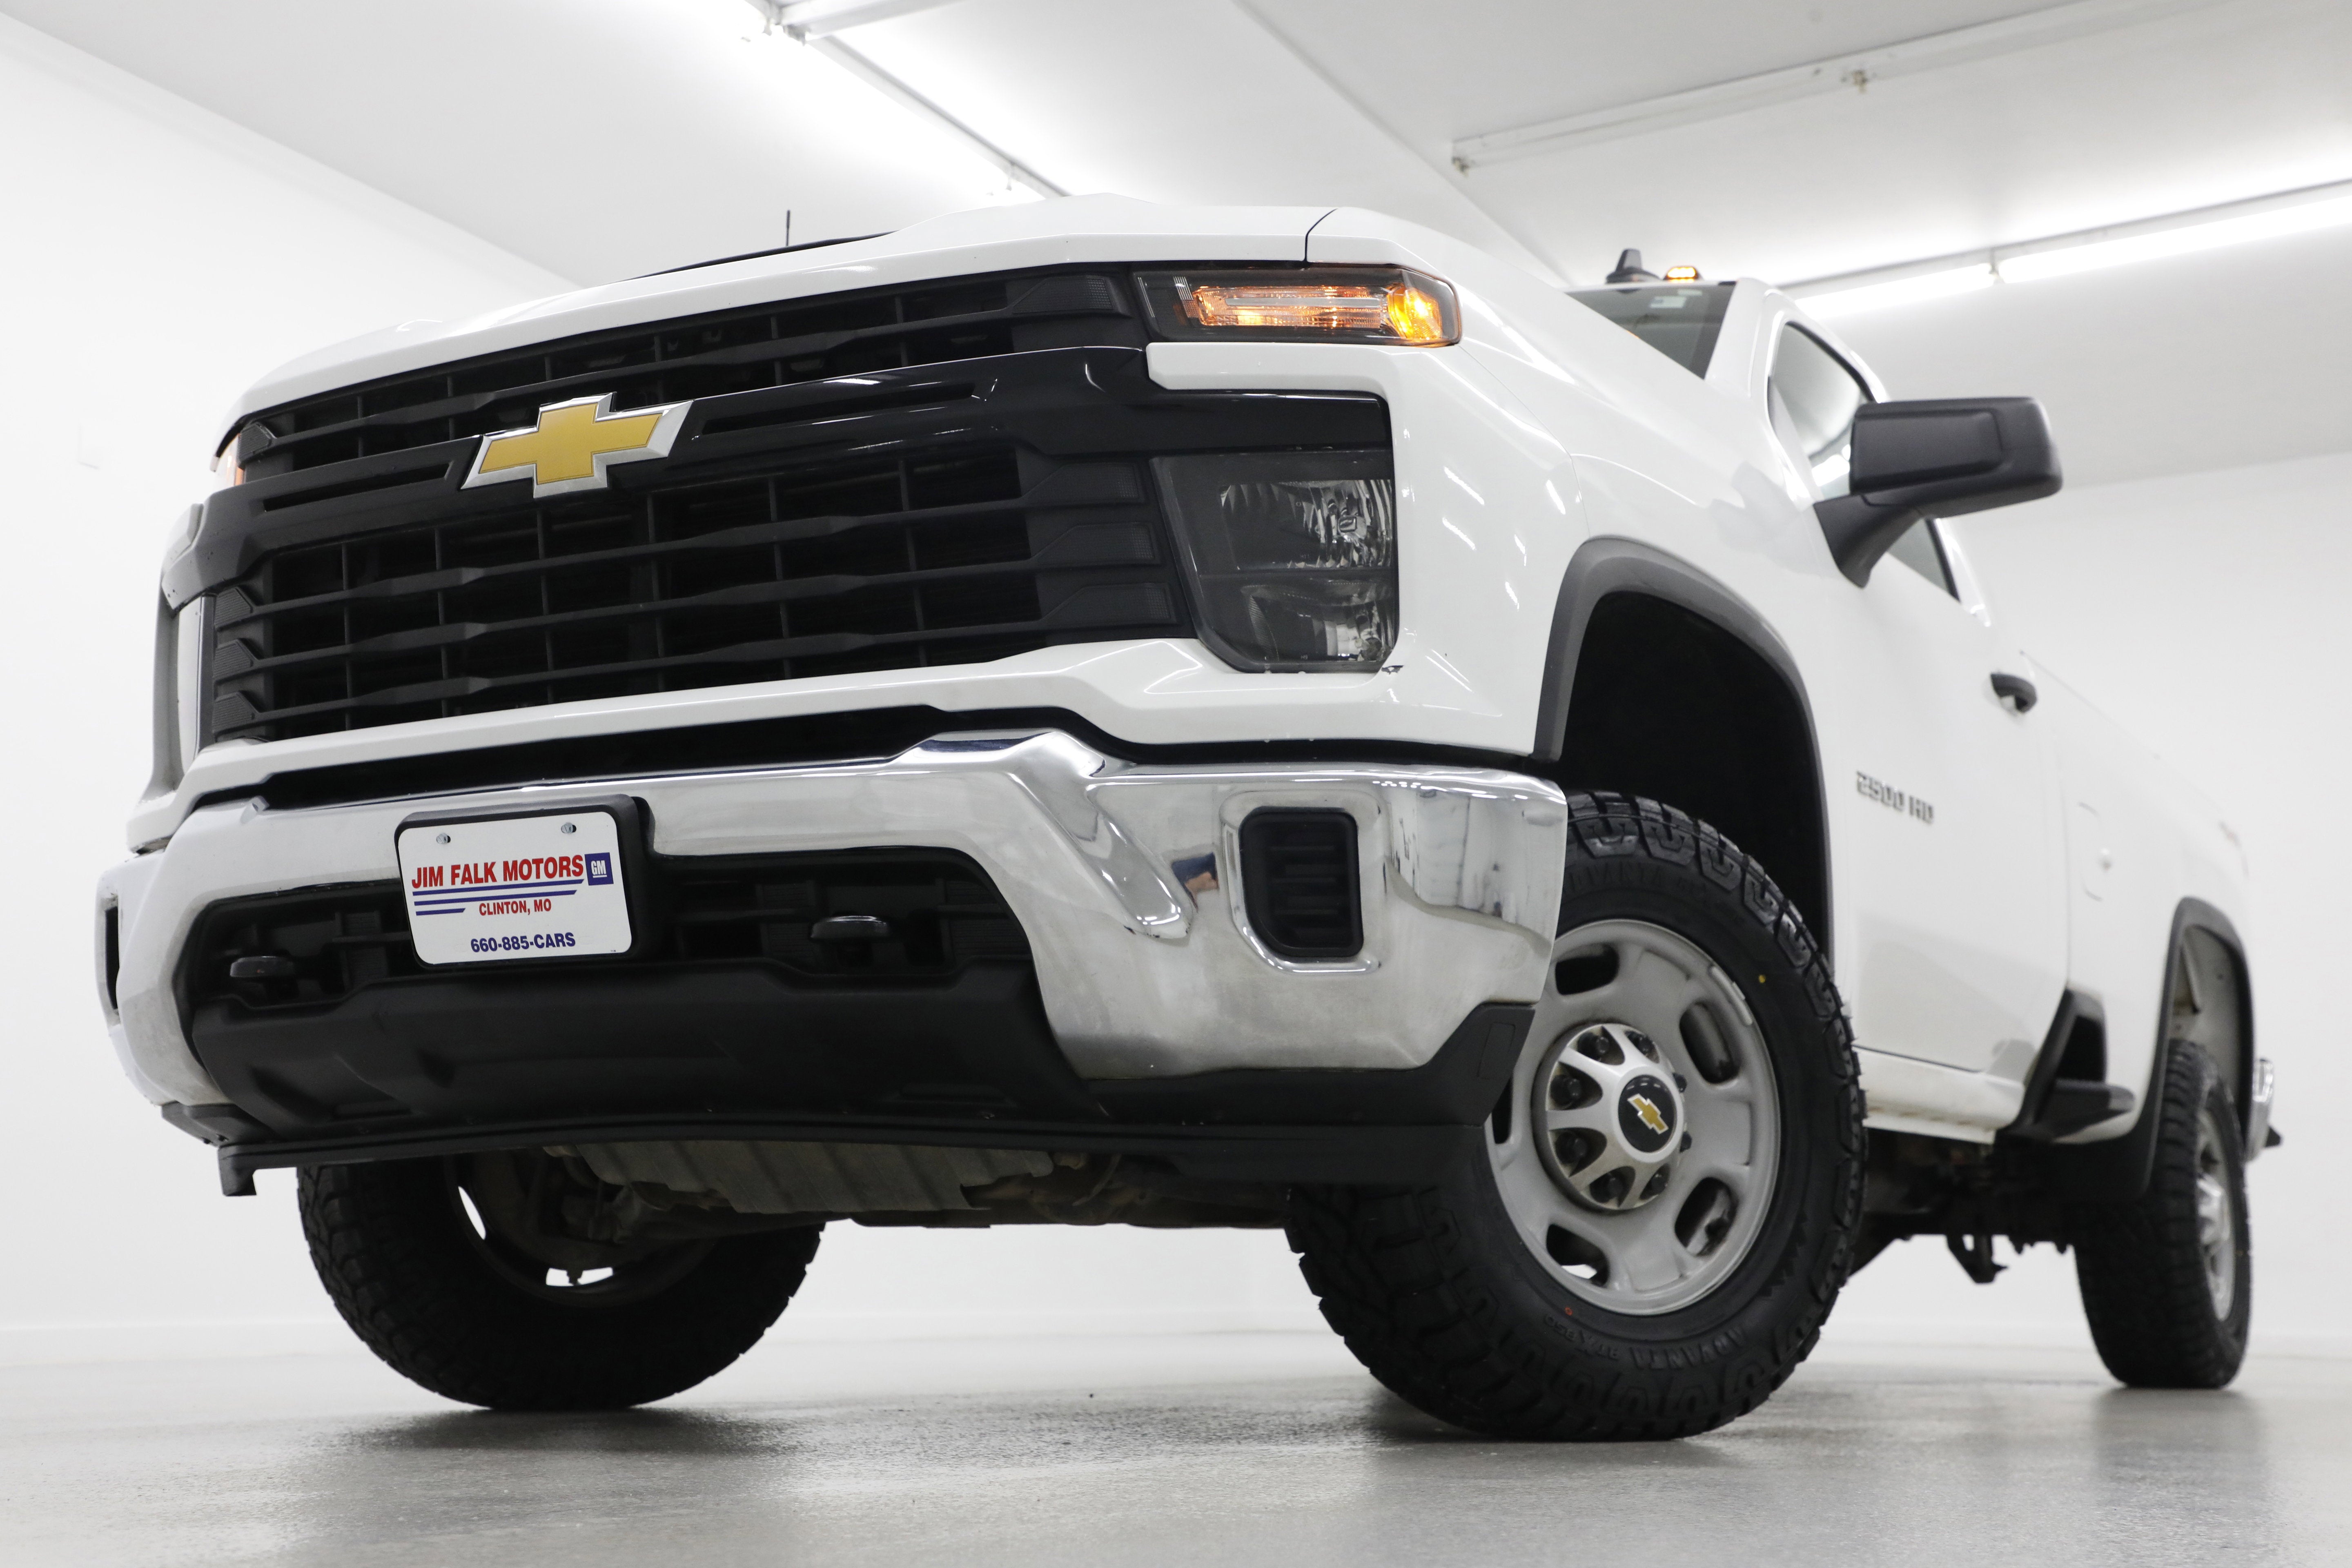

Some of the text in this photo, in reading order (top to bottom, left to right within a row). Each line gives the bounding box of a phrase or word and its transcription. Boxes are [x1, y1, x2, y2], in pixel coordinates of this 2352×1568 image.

[1856, 770, 1935, 825] 2500 HD
[412, 855, 584, 889] JIM FALK MOTORS
[591, 860, 607, 875] GM
[479, 899, 552, 916] CLINTON, MO
[471, 932, 575, 953] 660-885-CARS
[1629, 1326, 1744, 1370] ADVANTA
